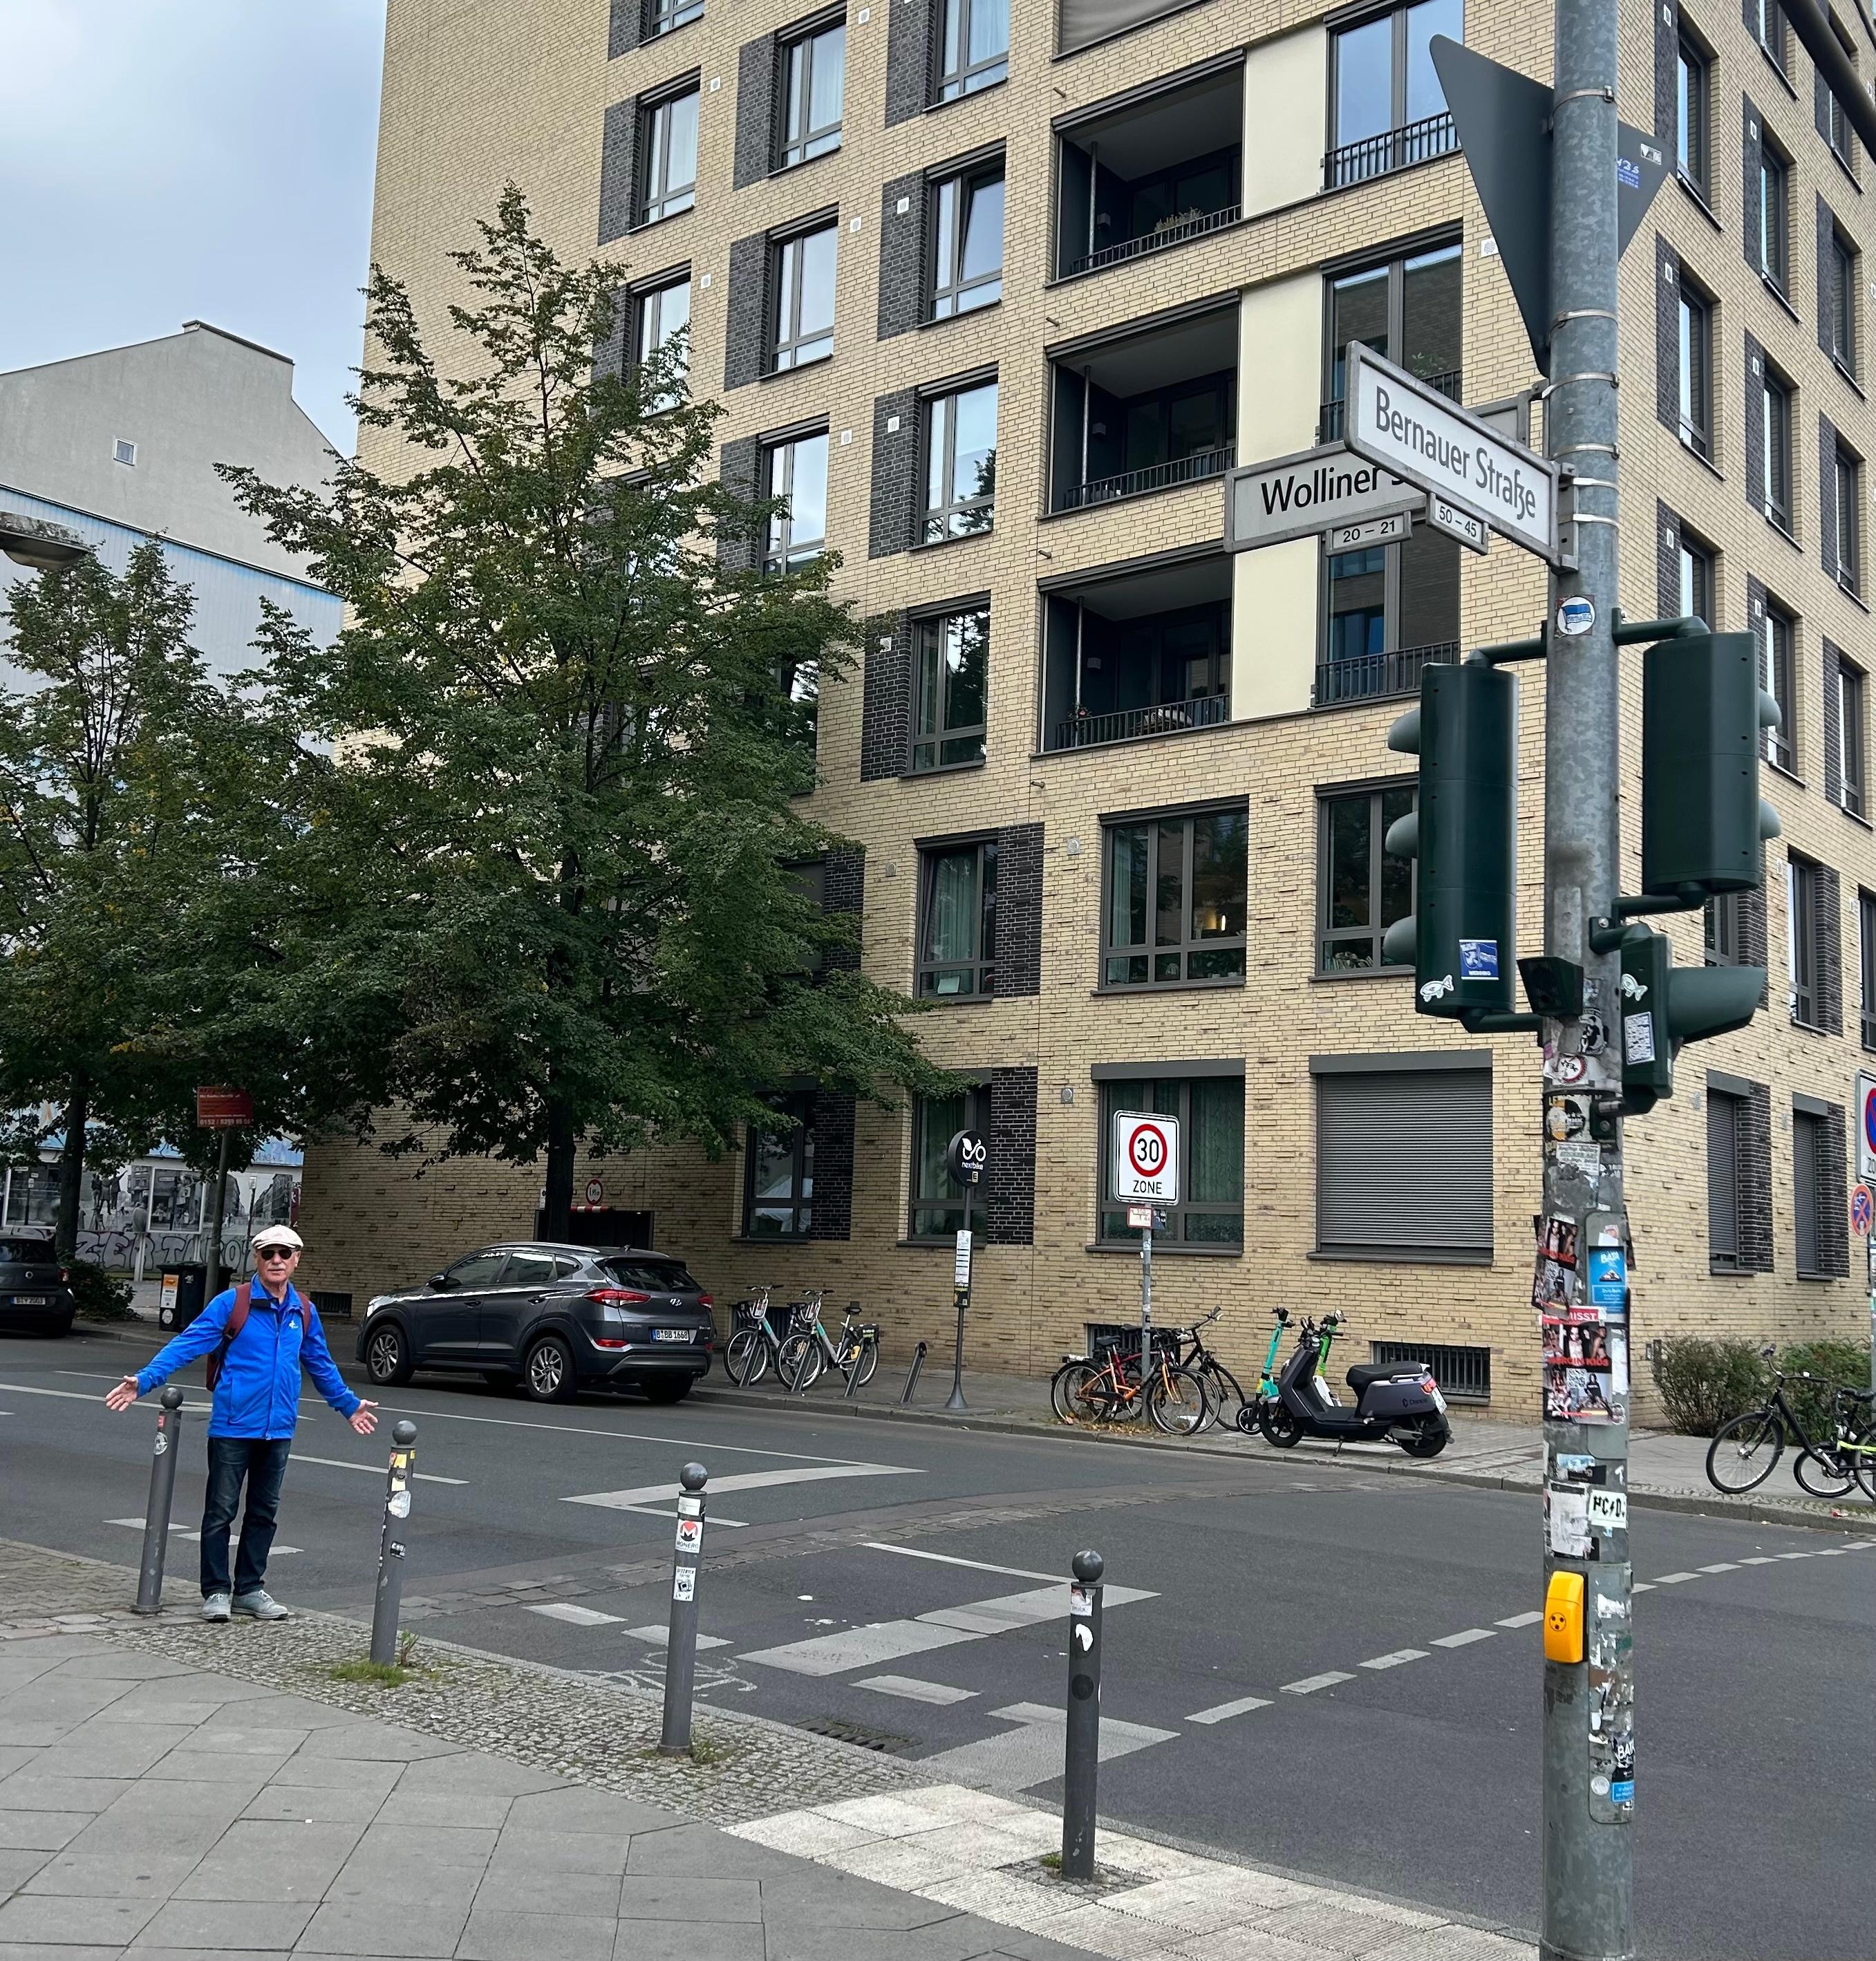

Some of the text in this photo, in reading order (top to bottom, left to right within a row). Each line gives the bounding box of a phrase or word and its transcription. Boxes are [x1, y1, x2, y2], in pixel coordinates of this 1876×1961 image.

[1376, 385, 1537, 521] Bernauer Straße
[1261, 465, 1382, 516] Wolliner
[1342, 529, 1361, 543] 20
[1380, 519, 1396, 534] 21
[1439, 505, 1453, 524] 50
[1464, 520, 1478, 538] 45
[1136, 1137, 1159, 1163] 30
[1868, 1157, 1876, 1174] ZO
[1133, 1179, 1163, 1194] ZONE
